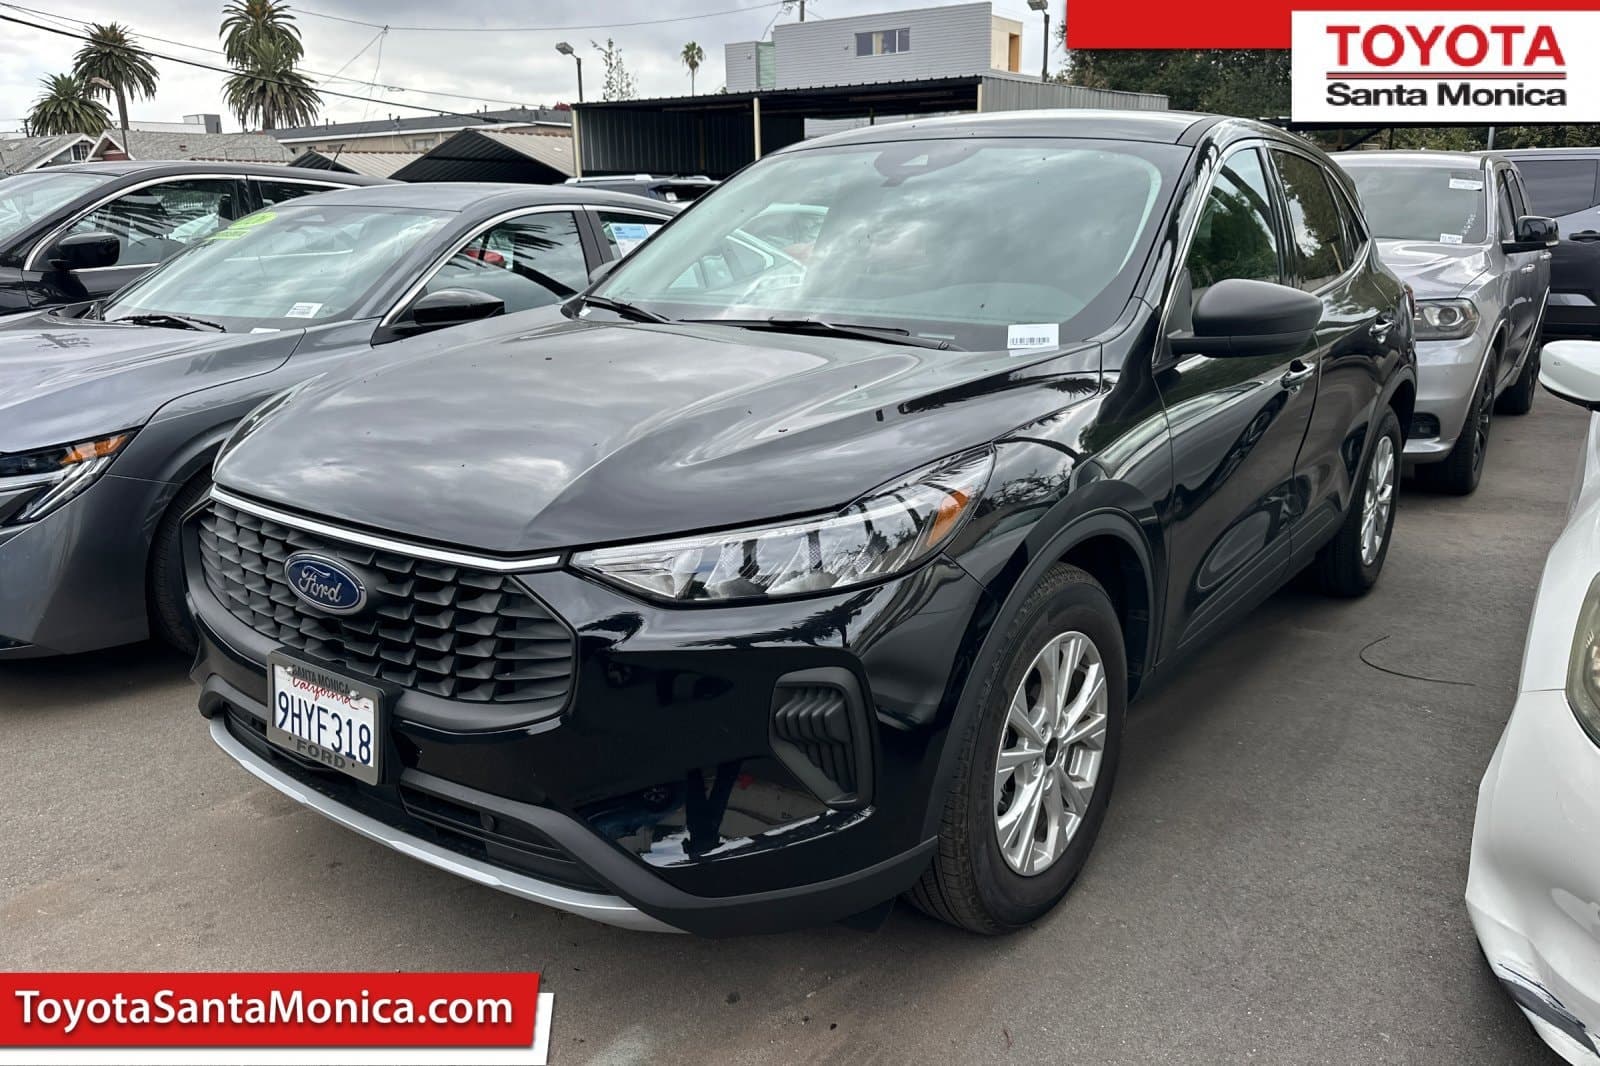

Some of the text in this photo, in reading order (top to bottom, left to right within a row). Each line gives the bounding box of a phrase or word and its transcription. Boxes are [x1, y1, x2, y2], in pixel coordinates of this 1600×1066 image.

[298, 565, 343, 603] Ford
[292, 664, 350, 695] SANTA MONICA
[278, 690, 371, 765] 9HYF318
[296, 739, 346, 769] FORD
